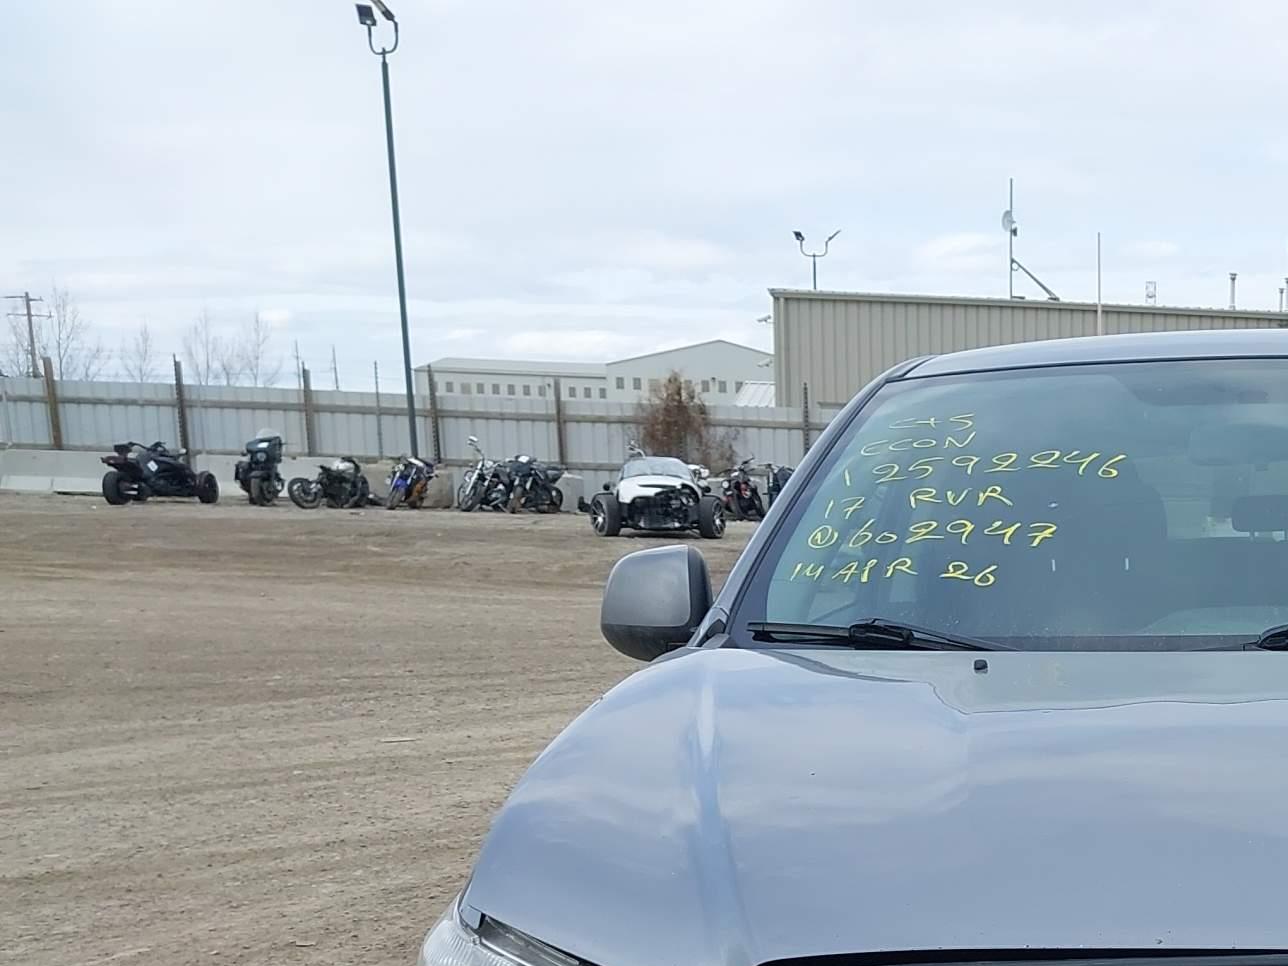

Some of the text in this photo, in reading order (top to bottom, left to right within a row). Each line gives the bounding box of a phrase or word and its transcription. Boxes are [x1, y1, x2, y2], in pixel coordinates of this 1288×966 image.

[825, 486, 1013, 519] 17 RVR
[832, 557, 918, 583] APR
[940, 561, 998, 586] 26
